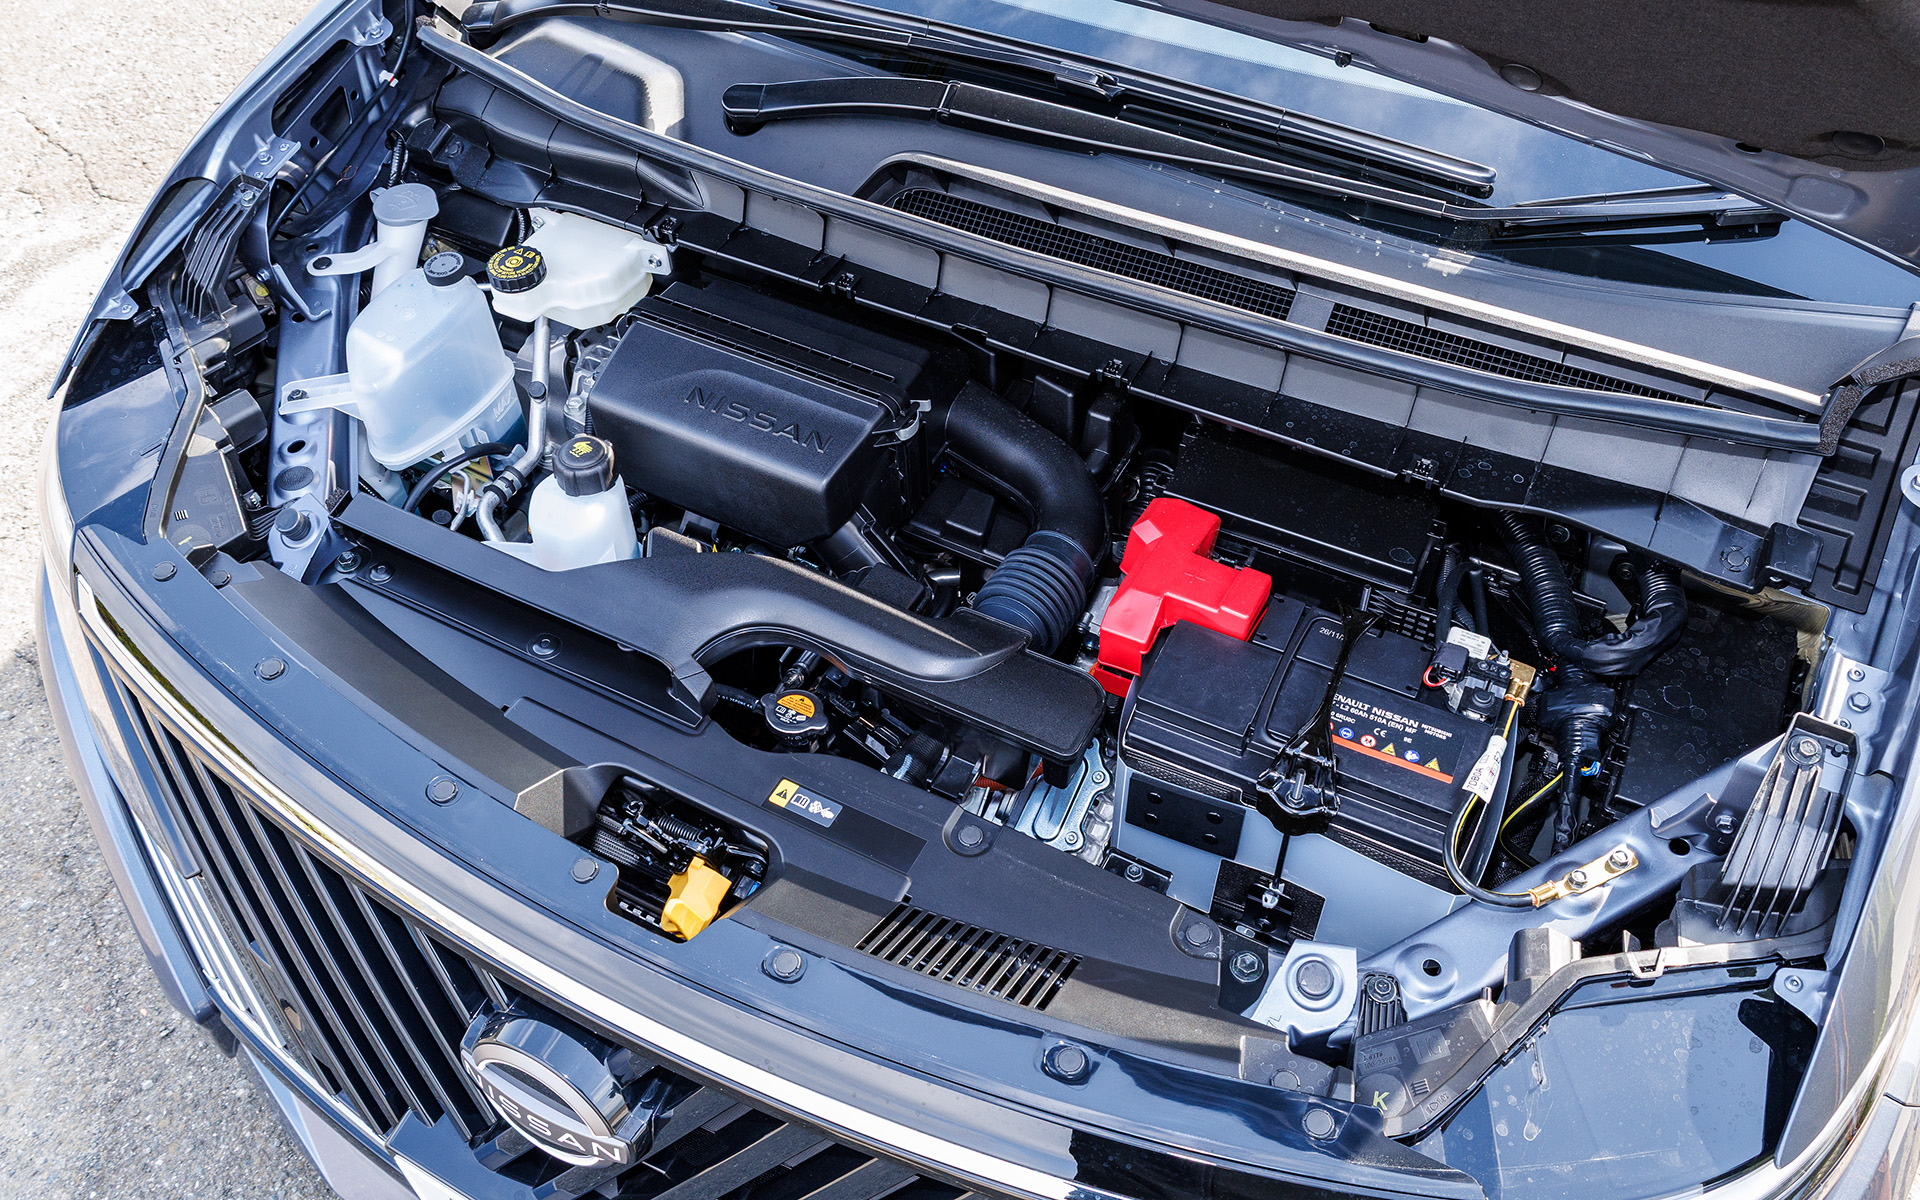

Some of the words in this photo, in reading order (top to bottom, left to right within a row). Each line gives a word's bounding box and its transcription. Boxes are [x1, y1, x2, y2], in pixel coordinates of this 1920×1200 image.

[683, 385, 834, 454] NISSAN
[1333, 693, 1371, 712] ENAULT
[1371, 706, 1420, 729] NISSAN
[463, 1058, 623, 1163] NISSAN
[1372, 1090, 1390, 1111] K
